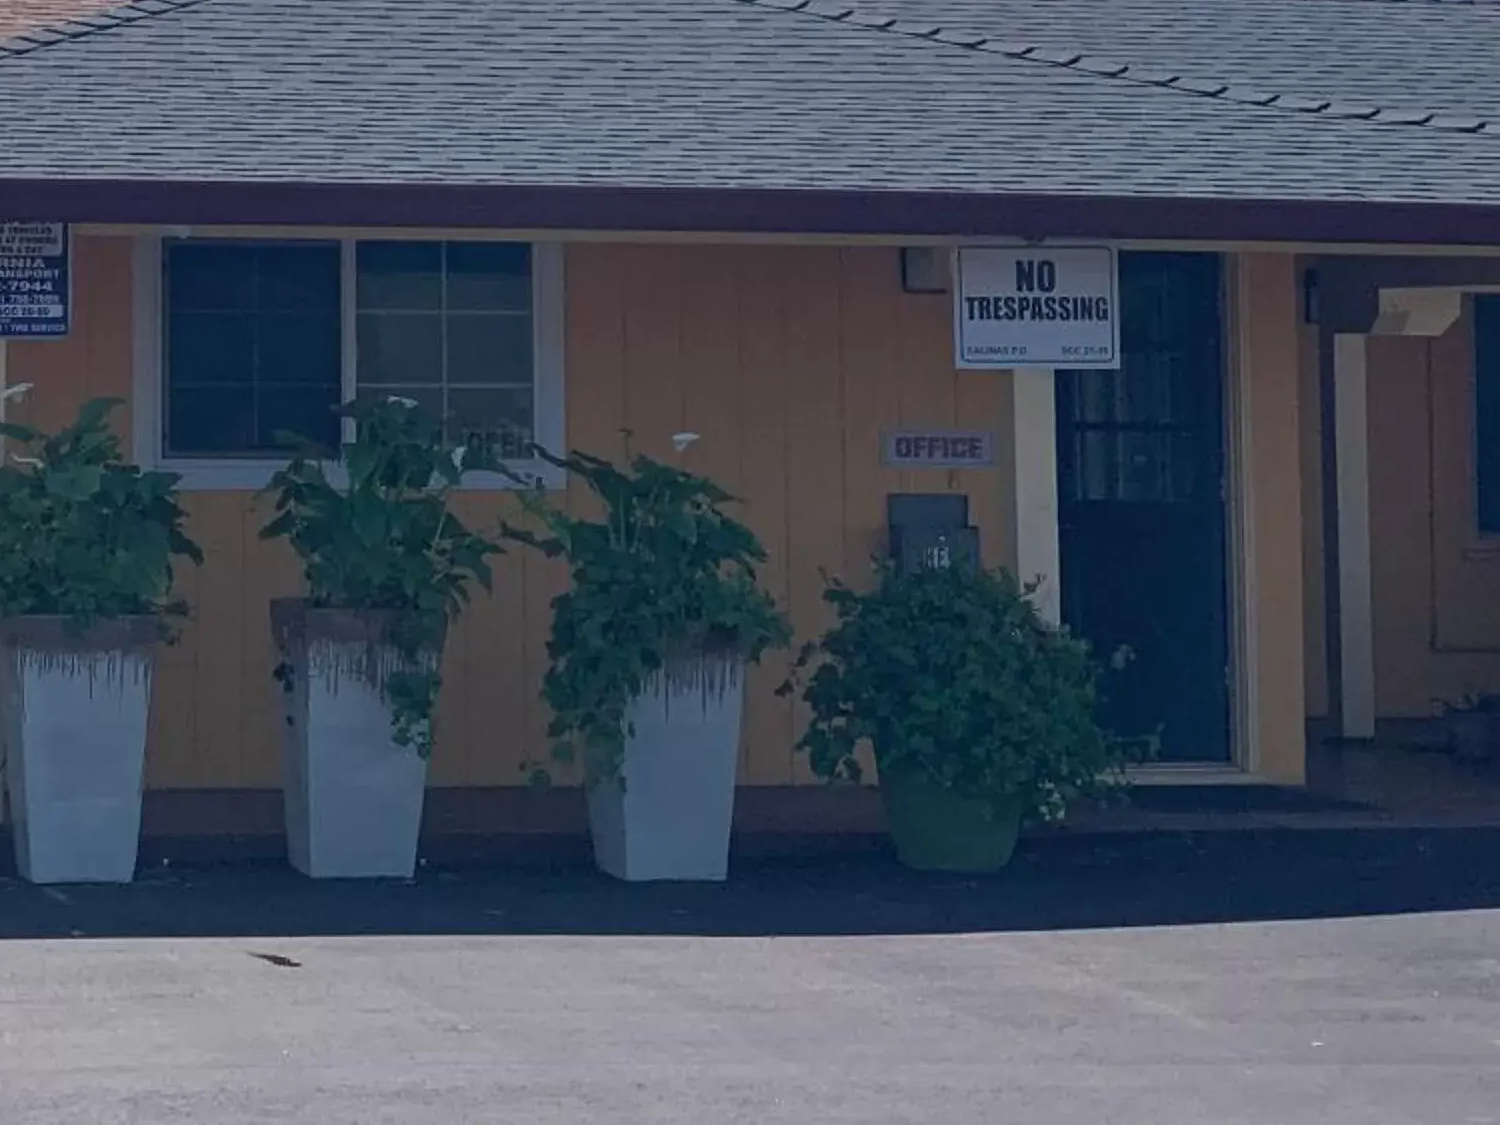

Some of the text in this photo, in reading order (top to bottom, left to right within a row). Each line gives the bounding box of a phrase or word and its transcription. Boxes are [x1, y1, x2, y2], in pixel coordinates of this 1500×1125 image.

[1015, 260, 1055, 292] NO
[964, 296, 1109, 322] TRESPASSING
[895, 437, 982, 459] OFFICE
